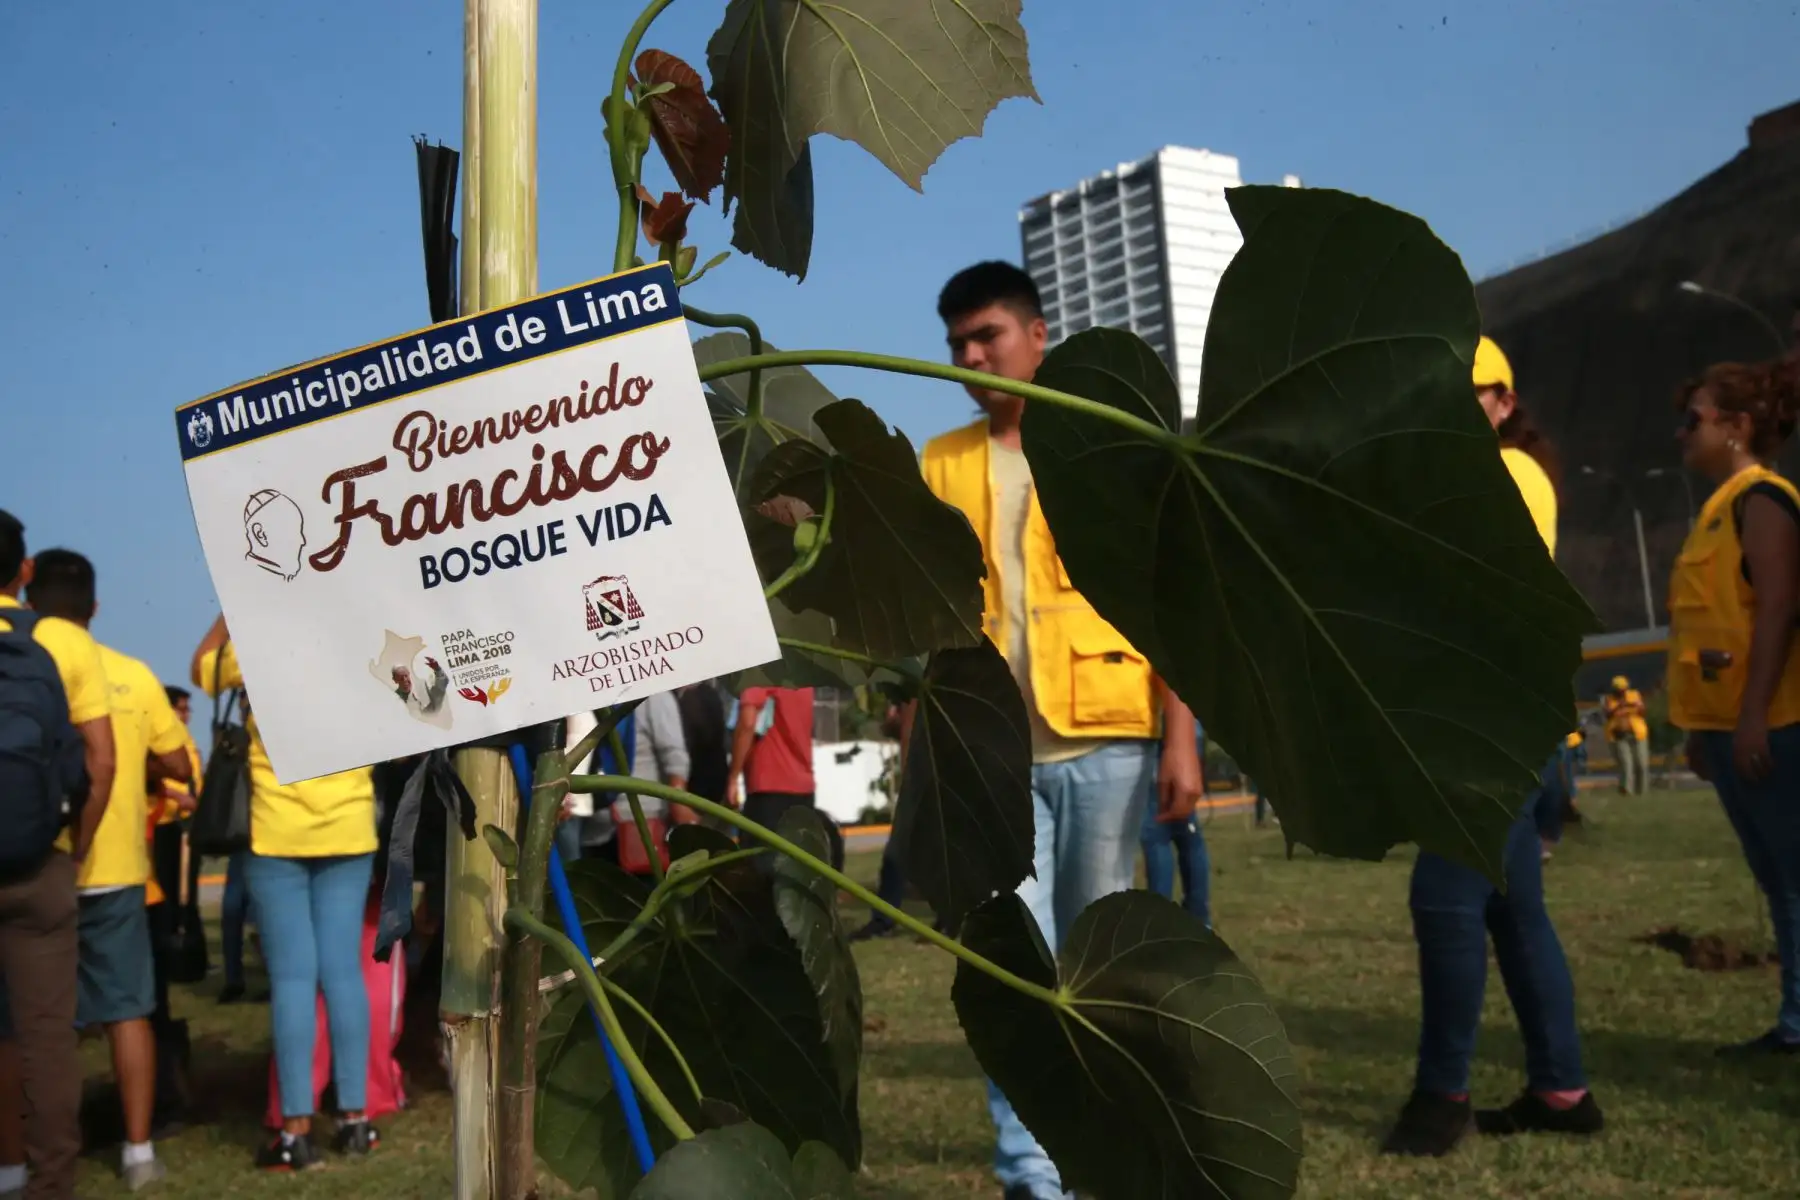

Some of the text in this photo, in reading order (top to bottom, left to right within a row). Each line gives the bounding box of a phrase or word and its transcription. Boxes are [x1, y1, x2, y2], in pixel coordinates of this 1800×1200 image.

[217, 282, 667, 436] Municipalidad de Lima
[393, 362, 653, 473] Bienvenido
[309, 430, 671, 572] Francisco
[419, 493, 672, 590] BOSQUE VIDA
[441, 628, 475, 645] PAPA
[444, 631, 515, 657] FRANCISCO
[552, 626, 704, 681] ARZOBISPADO
[447, 644, 512, 669] LIMA 2018
[459, 664, 500, 680] UNIDOS POR
[588, 656, 674, 693] DE LIMA
[460, 668, 511, 686] LA ESPERANZA
